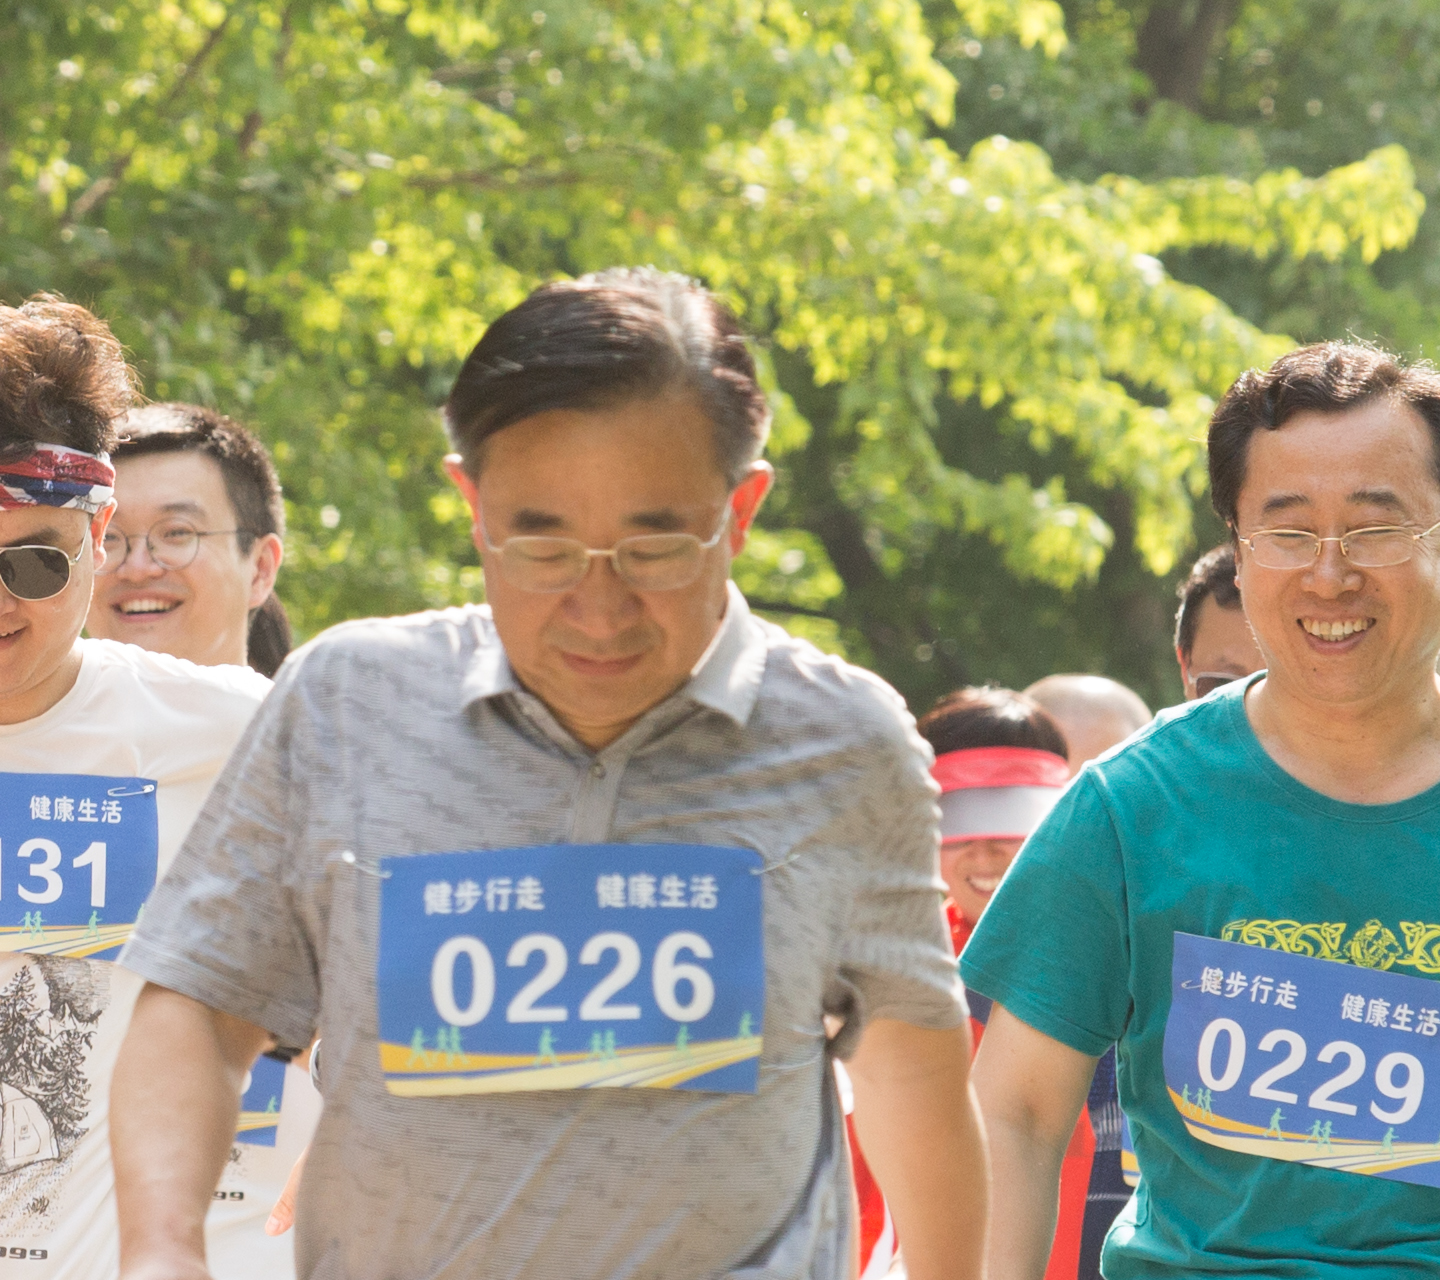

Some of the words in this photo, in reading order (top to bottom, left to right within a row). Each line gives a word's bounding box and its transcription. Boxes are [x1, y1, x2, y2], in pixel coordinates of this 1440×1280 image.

[28, 794, 123, 824] 健康生活
[423, 876, 546, 915] 健步行走
[595, 873, 719, 910] 健康生活
[430, 930, 715, 1027] 0226
[1200, 965, 1299, 1010] 健步行走
[1340, 993, 1440, 1037] 健康生活
[1196, 1018, 1425, 1124] 0229
